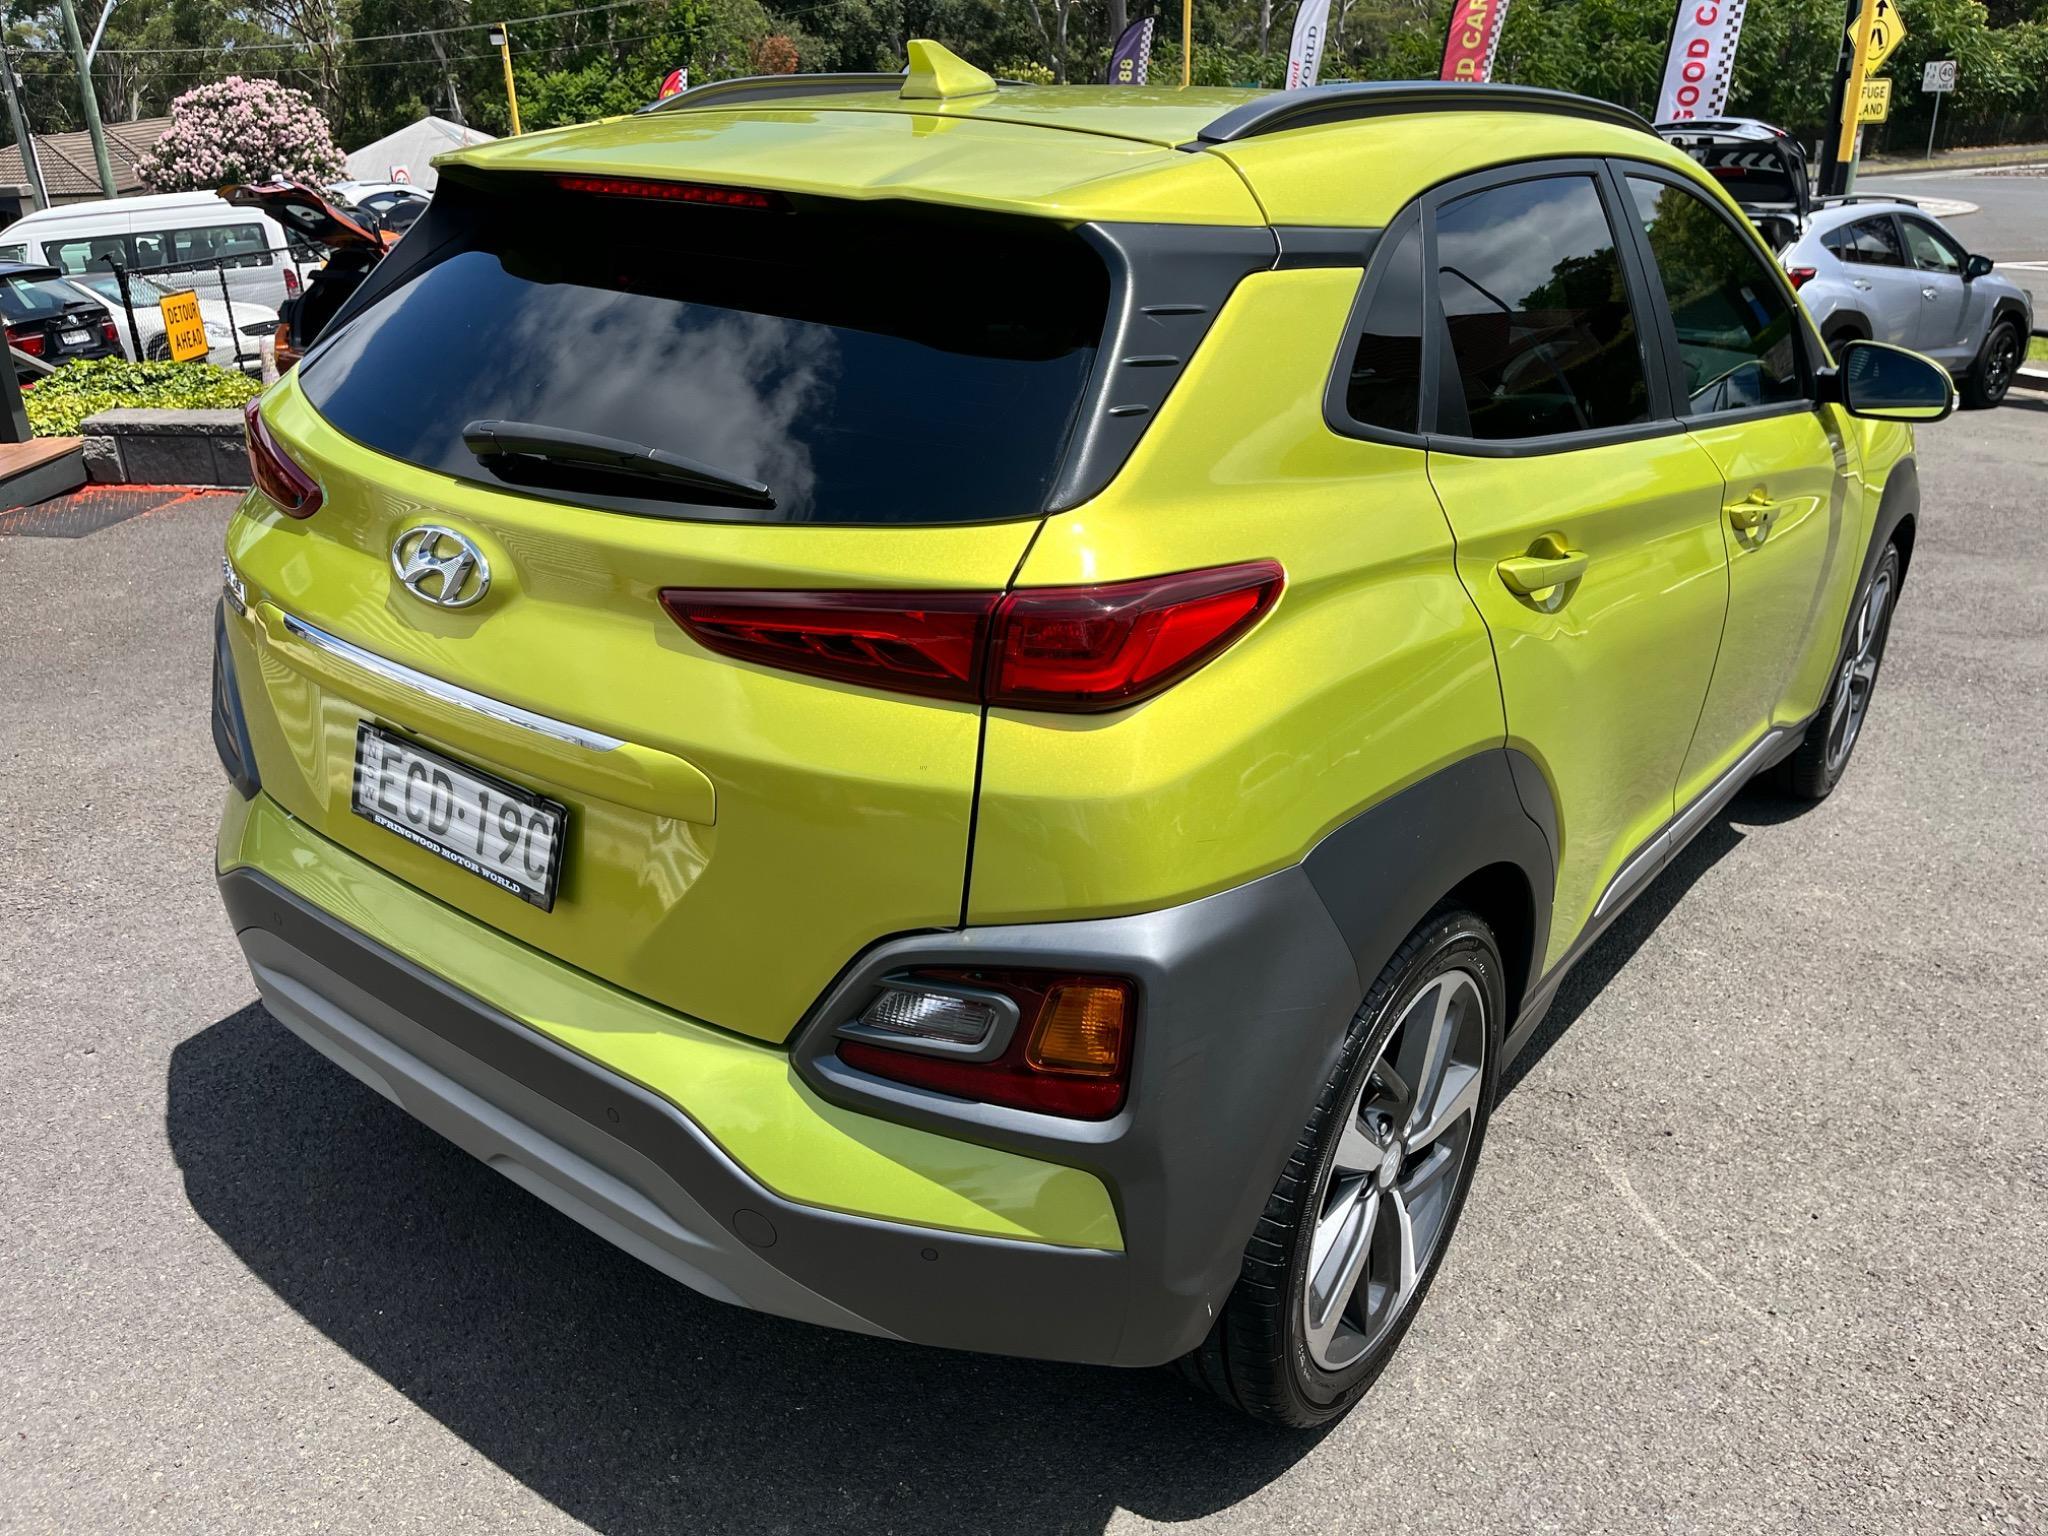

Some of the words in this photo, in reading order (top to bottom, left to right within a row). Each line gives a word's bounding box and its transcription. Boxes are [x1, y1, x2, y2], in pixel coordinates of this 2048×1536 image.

[1118, 59, 1134, 82] 88
[1942, 67, 1953, 77] 40
[167, 302, 199, 325] DETOUR
[176, 328, 203, 352] AHEAD
[374, 814, 441, 853] SPRINGWOOD
[441, 848, 480, 873] MOTOR
[481, 867, 521, 894] WORLD
